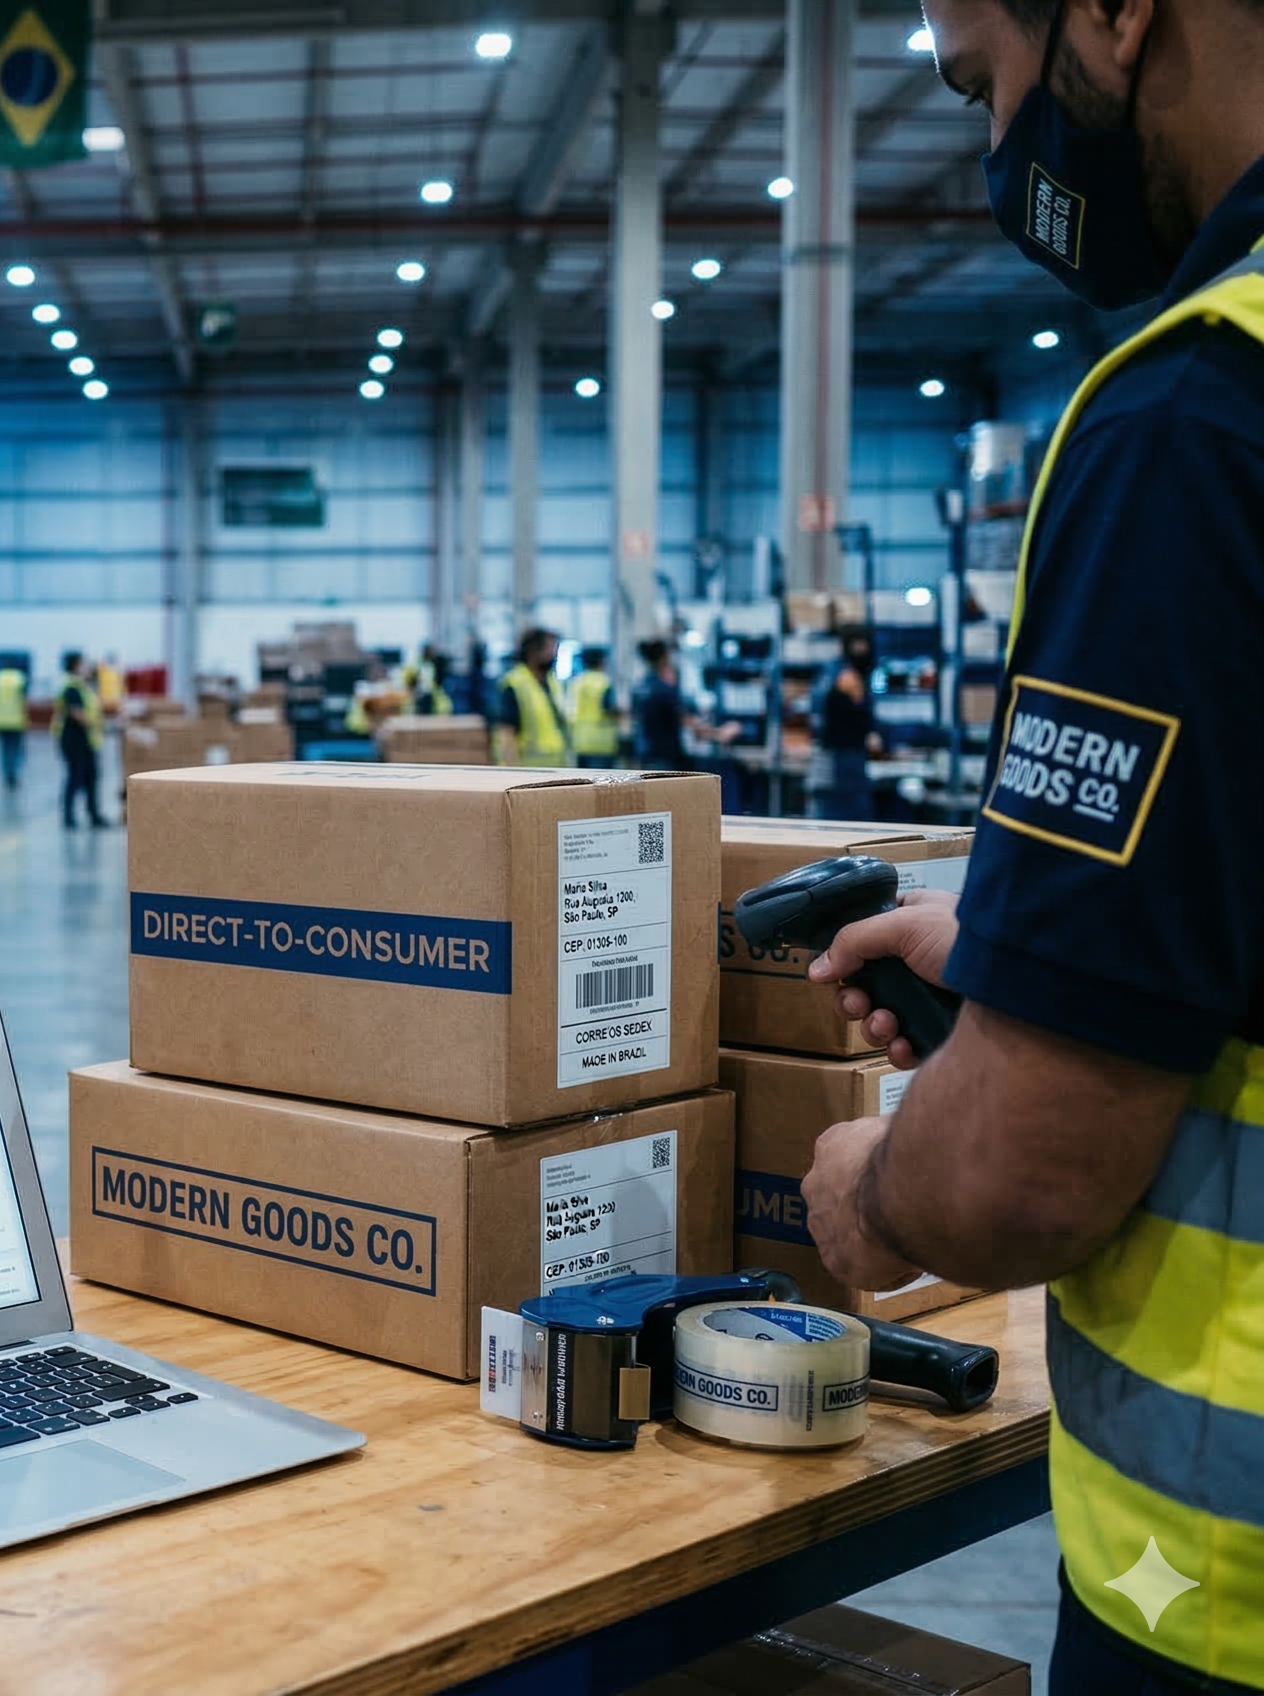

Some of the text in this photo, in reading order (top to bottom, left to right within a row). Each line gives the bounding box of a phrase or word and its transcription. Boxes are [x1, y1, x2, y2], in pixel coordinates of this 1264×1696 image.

[1010, 711, 1141, 782] MODERN
[999, 753, 1120, 814] GOODS CO.
[607, 906, 619, 918] SP
[143, 910, 491, 973] DIRECT-TO-CONSUMER
[623, 1019, 653, 1036] SEDEX
[608, 1052, 617, 1063] IN
[102, 1166, 423, 1273] MODERN GOODS CO.
[698, 1377, 743, 1401] GOODS
[747, 1389, 771, 1405] CO.
